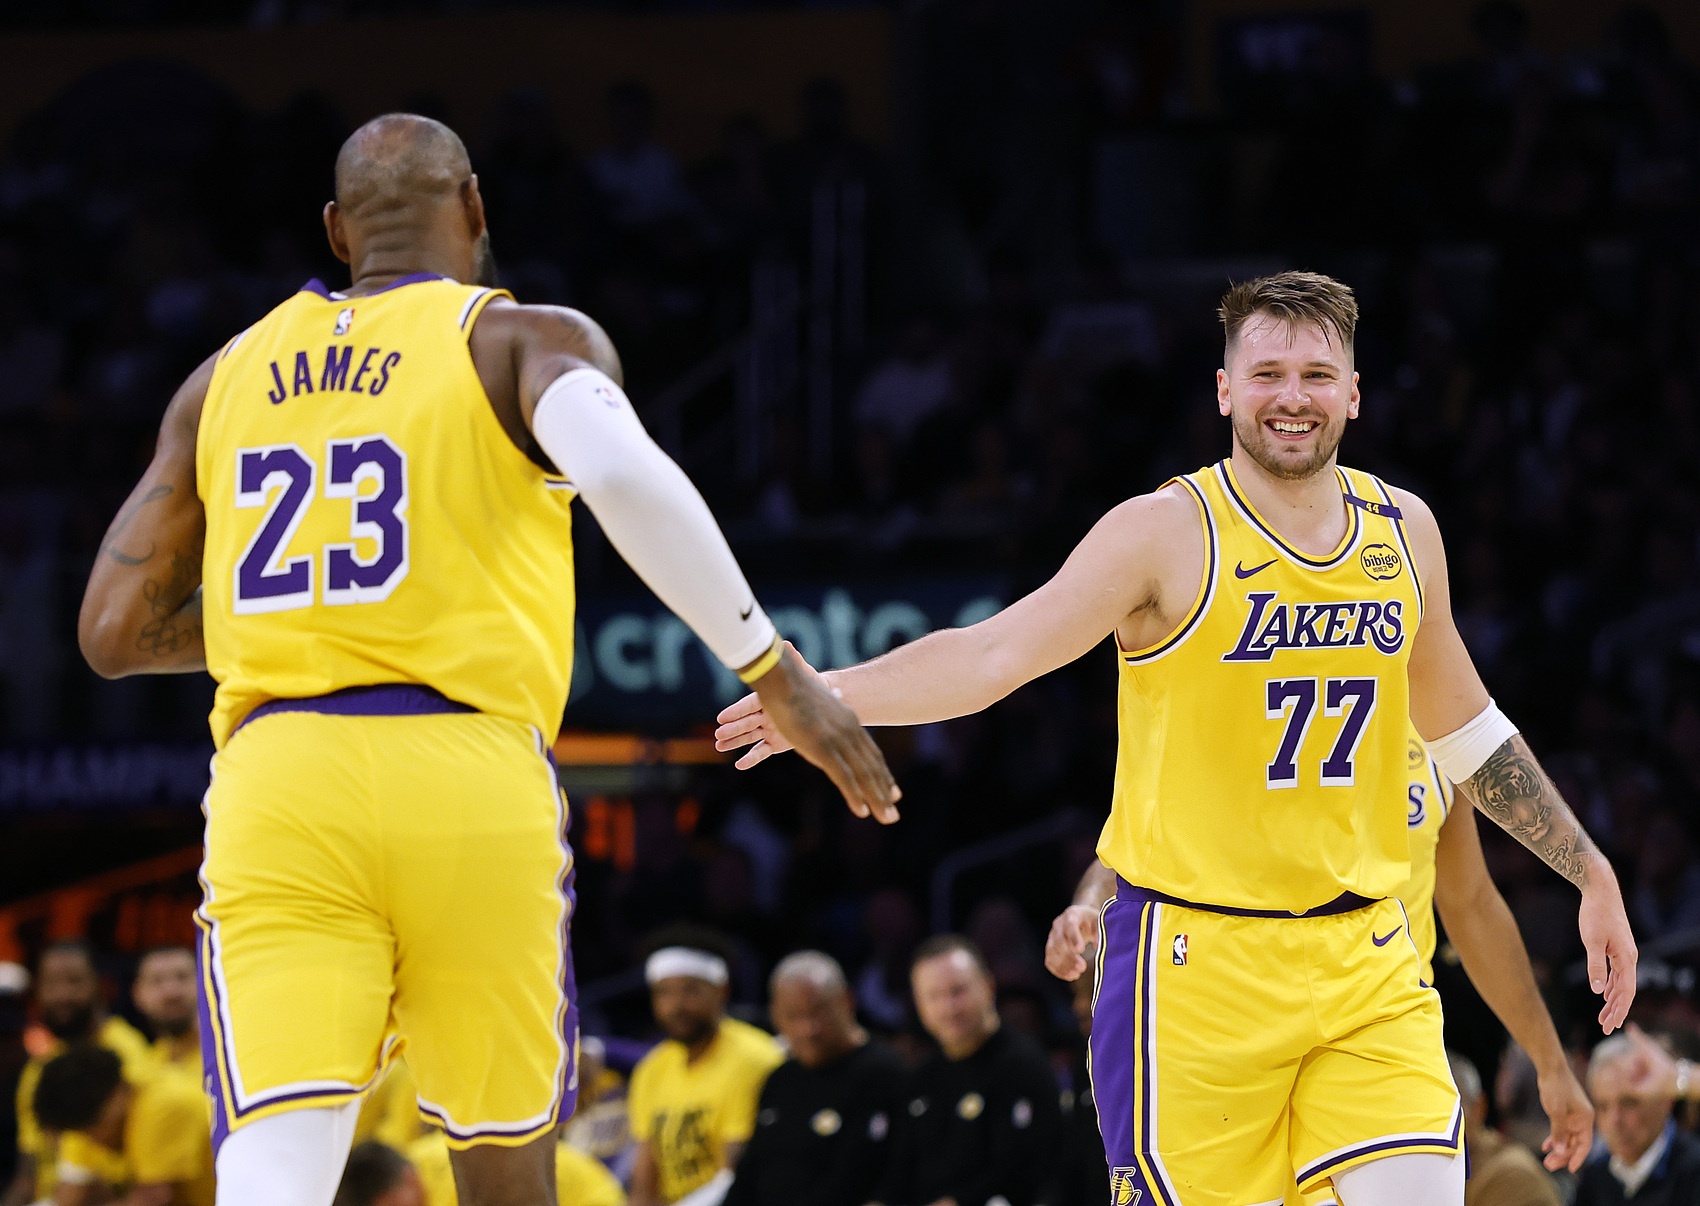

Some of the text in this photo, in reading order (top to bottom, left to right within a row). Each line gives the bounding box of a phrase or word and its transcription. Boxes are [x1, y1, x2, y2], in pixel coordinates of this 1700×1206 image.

[268, 345, 401, 405] JAMES
[232, 432, 410, 616] 23
[1366, 503, 1379, 513] 44
[1364, 553, 1398, 568] bibigo
[1221, 591, 1405, 661] LAKERS
[1265, 675, 1379, 791] 77
